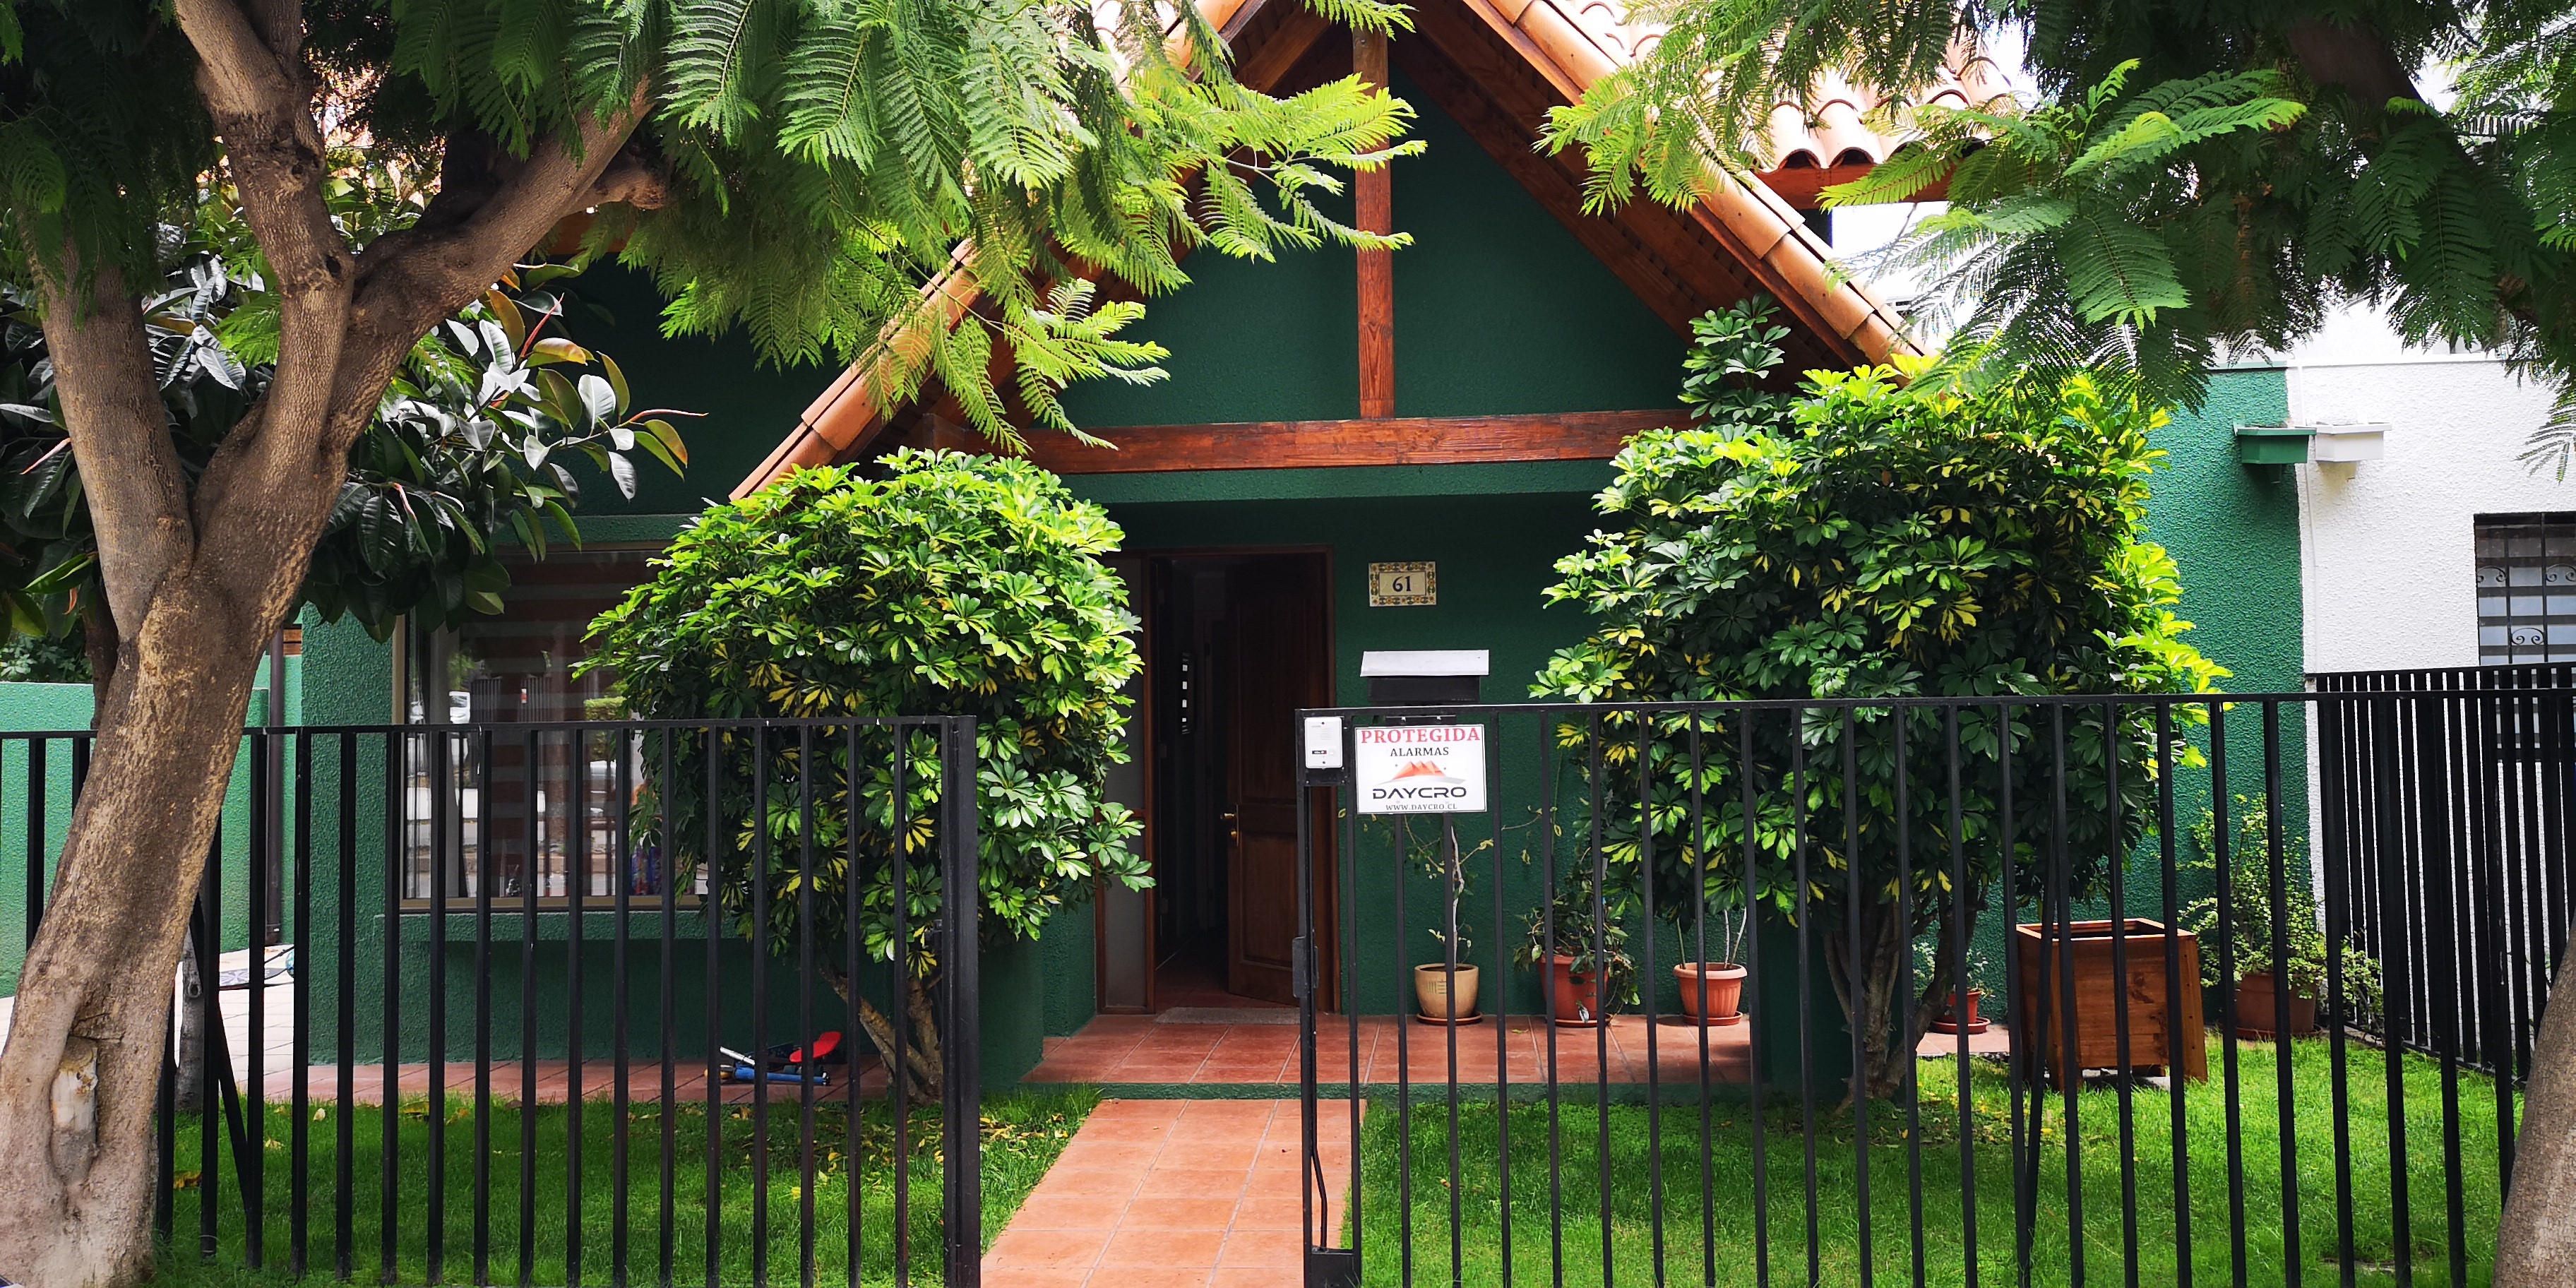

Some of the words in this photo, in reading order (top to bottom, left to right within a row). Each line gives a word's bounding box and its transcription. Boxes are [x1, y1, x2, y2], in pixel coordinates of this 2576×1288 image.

[1393, 576, 1411, 592] 61
[1361, 727, 1480, 743] PROTEGIDA
[1390, 747, 1449, 756] ALARMAS
[1373, 787, 1467, 799] DAYCRO
